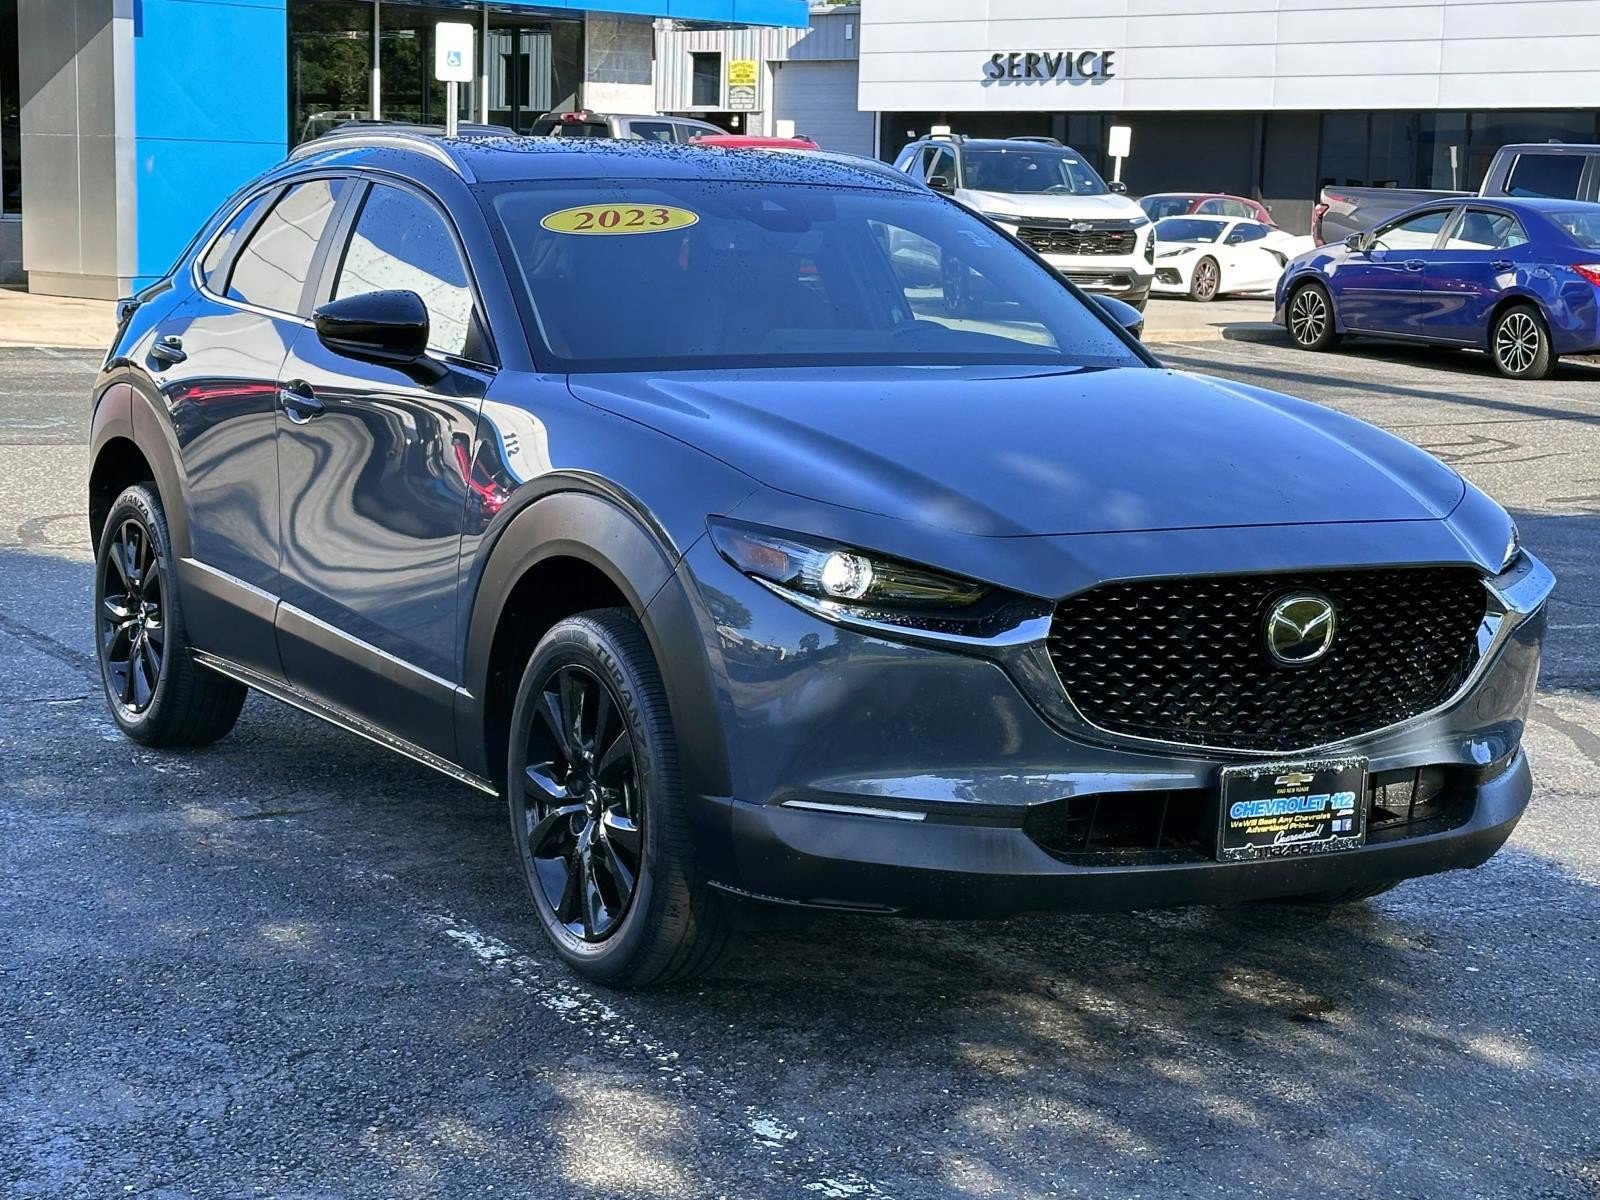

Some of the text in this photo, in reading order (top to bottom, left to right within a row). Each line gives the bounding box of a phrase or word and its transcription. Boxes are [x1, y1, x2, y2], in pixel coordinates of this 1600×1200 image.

[989, 50, 1116, 79] SERVICE
[573, 208, 670, 231] 2023
[597, 643, 651, 771] TURANZA
[1230, 791, 1356, 819] CHEVROLET 112
[1278, 816, 1293, 824] Any
[1294, 813, 1331, 822] Chevrolet
